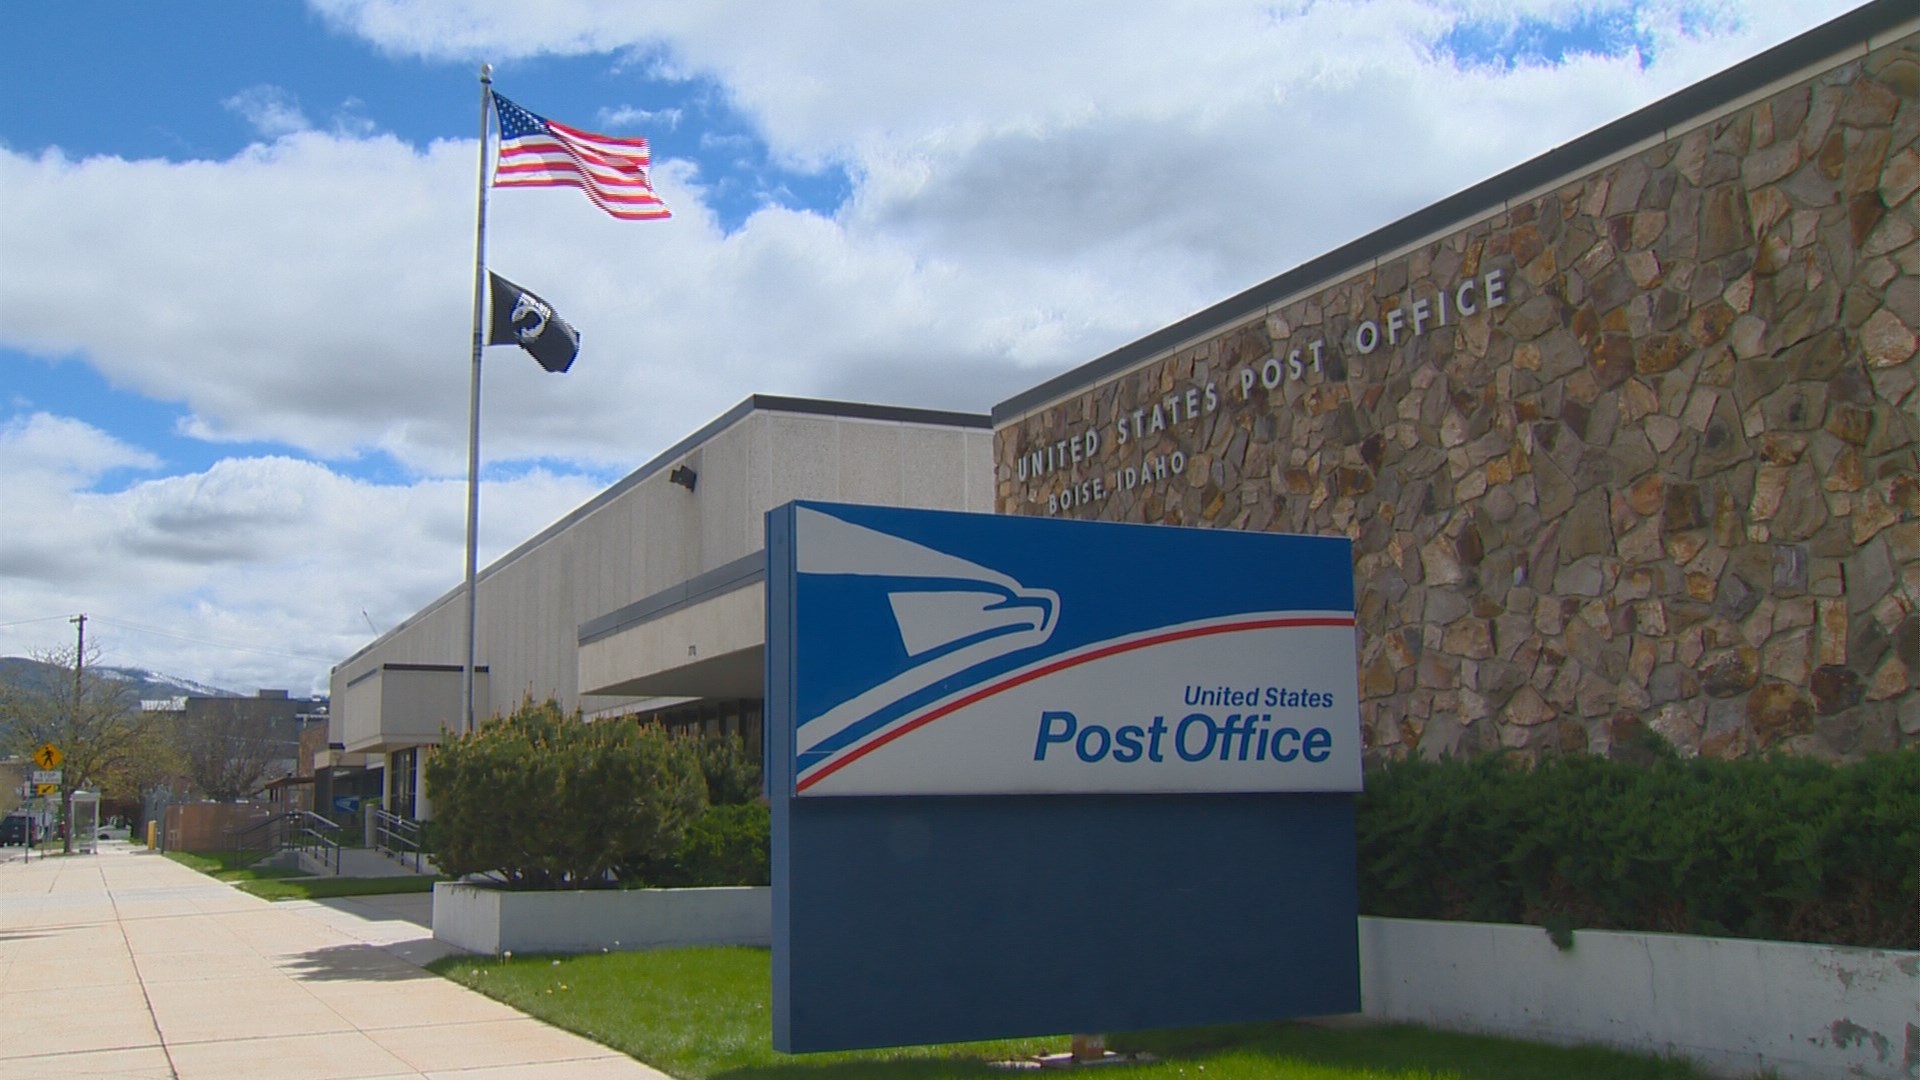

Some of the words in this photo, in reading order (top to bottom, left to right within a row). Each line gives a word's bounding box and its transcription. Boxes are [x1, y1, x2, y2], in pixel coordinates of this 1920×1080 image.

[1018, 429, 1099, 482] UNITED
[1118, 383, 1218, 445] STATES
[1241, 339, 1324, 400] POST
[1356, 269, 1506, 354] OFFICE
[1117, 451, 1186, 493] IDAHO
[1184, 685, 1260, 707] United
[1264, 686, 1334, 708] States
[1033, 711, 1168, 763] Post
[1174, 713, 1332, 763] Office
